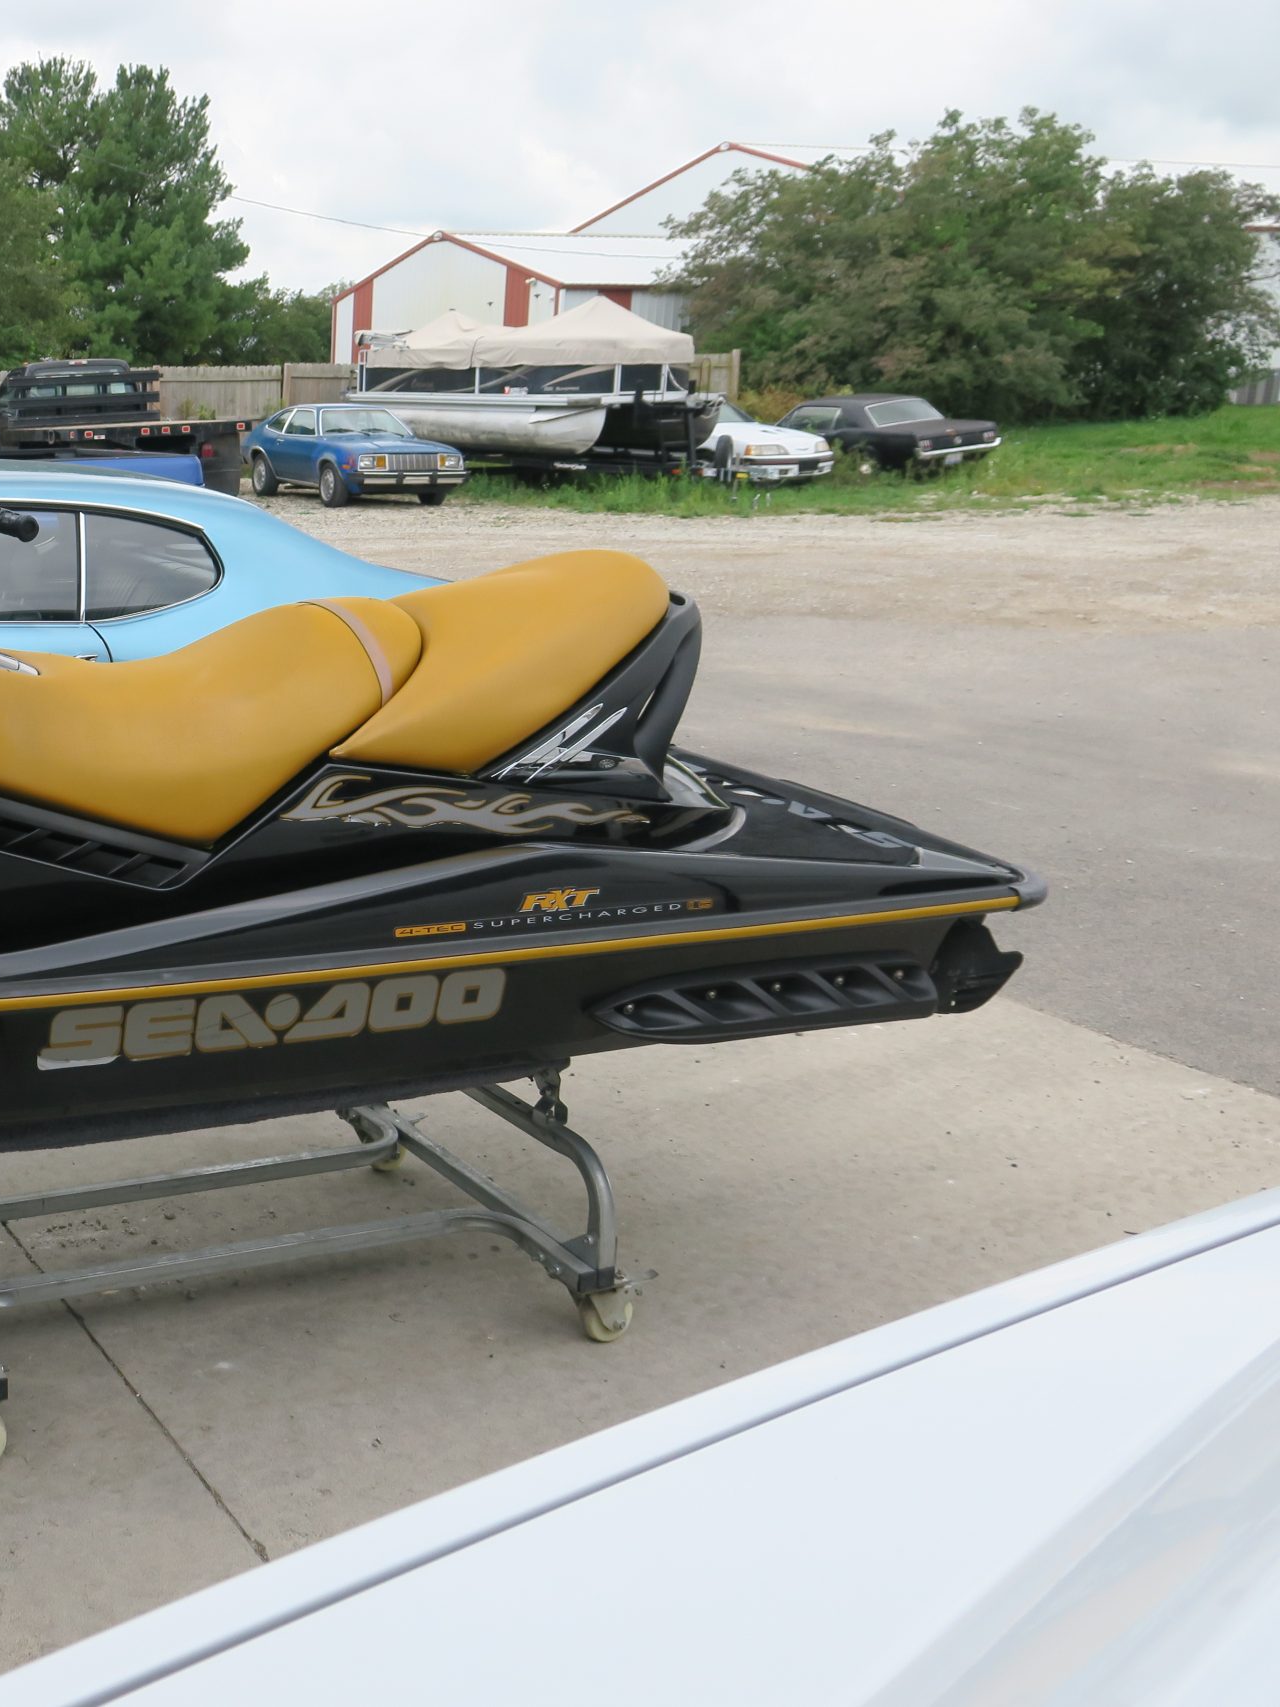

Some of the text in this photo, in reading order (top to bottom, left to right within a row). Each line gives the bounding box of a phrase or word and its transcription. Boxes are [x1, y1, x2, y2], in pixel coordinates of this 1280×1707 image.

[519, 887, 601, 913] RXT
[396, 923, 465, 938] 4-TEC
[472, 903, 682, 930] SUPERCHARGED
